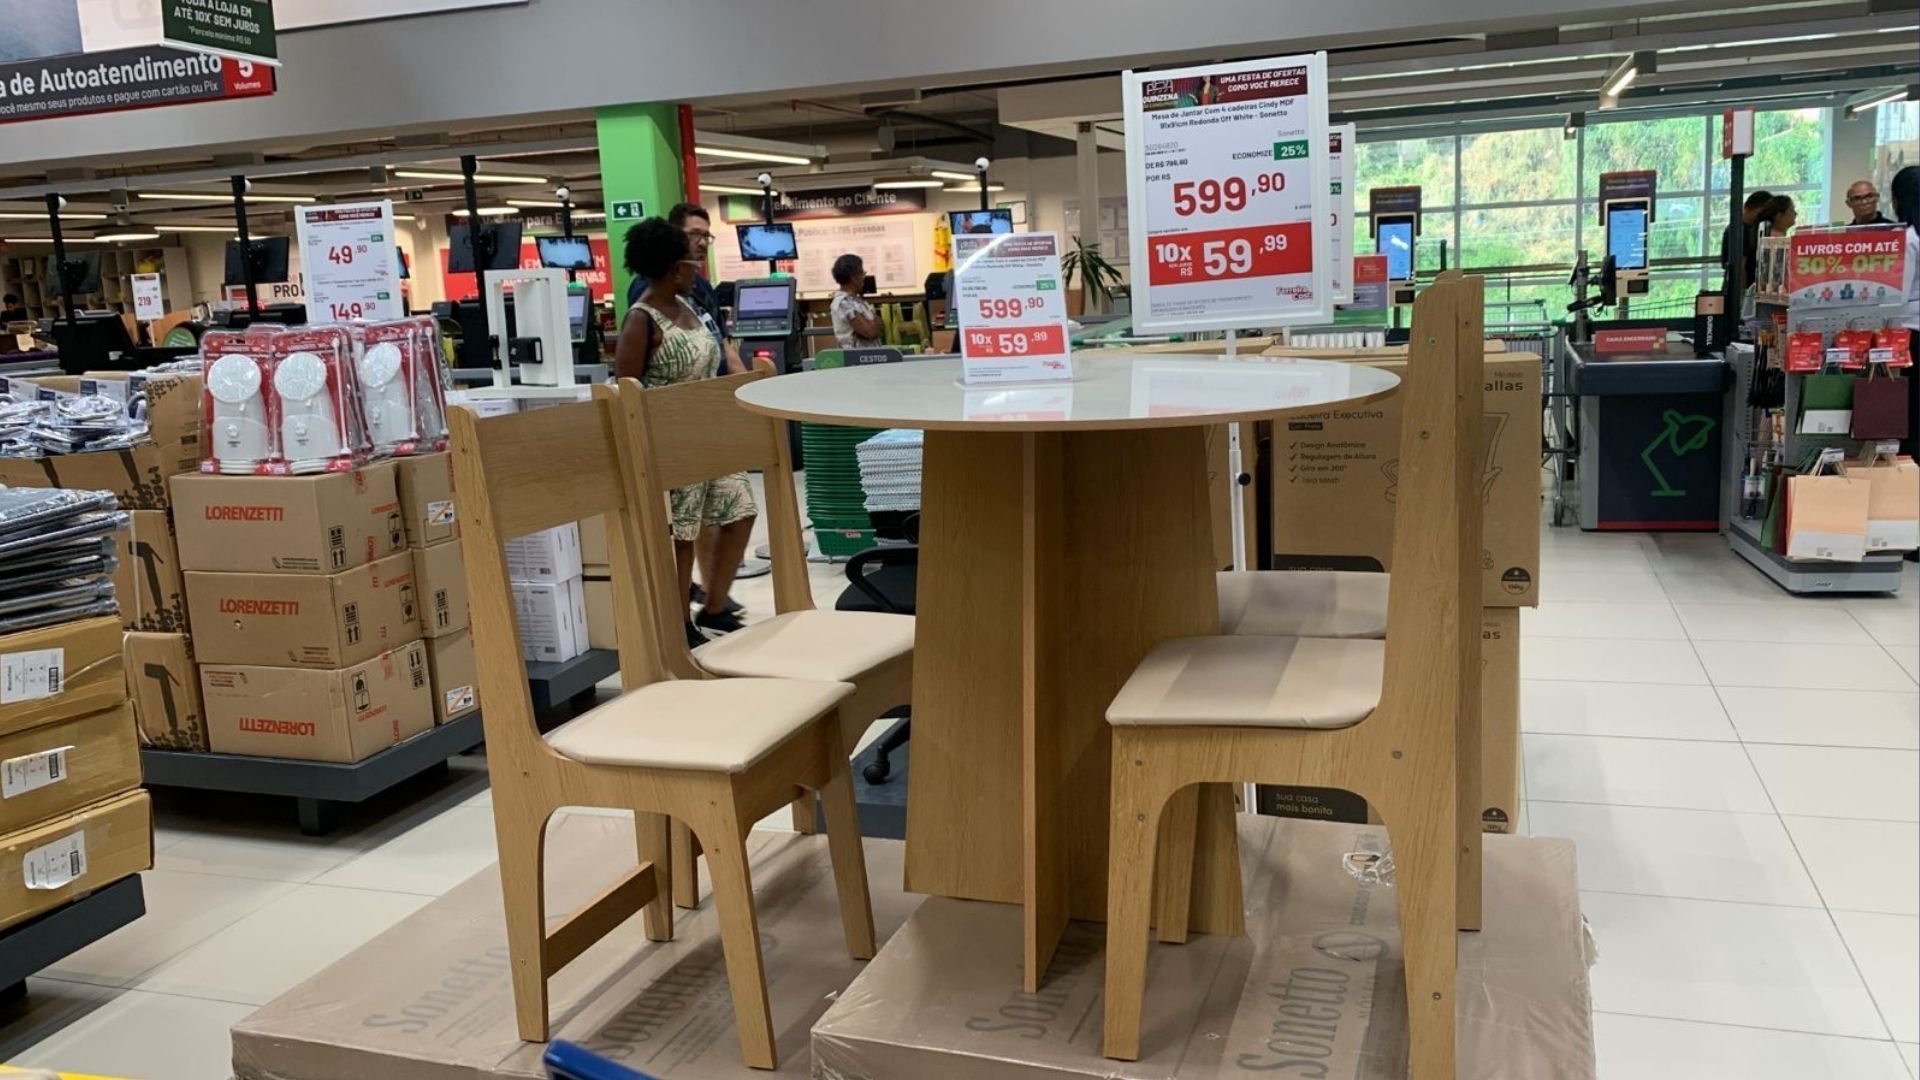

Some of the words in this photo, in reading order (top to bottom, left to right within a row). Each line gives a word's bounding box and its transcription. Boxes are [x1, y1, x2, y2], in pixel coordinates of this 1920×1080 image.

[215, 1, 239, 14] LOJA
[240, 6, 252, 17] EM
[173, 6, 193, 20] ATÉ
[194, 10, 212, 23] 10X
[213, 14, 231, 28] SEM
[233, 19, 260, 34] JUROS
[10, 72, 35, 96] de
[41, 52, 222, 93] Autoatendimento
[238, 59, 253, 78] 5
[1220, 76, 1236, 84] UMA
[1238, 73, 1261, 81] FESTA
[1273, 68, 1306, 78] OFERTAS
[233, 81, 261, 90] Volumes
[1227, 84, 1248, 92] COMO
[1250, 81, 1269, 90] VOCÊ
[1269, 78, 1299, 88] MERECE
[16, 101, 47, 113] mesmo
[47, 99, 67, 109] seus
[68, 94, 106, 109] produtos
[107, 94, 112, 102] e
[113, 91, 140, 104] pague
[141, 89, 160, 99] com
[161, 84, 190, 97] cartão
[191, 84, 203, 93] ou
[203, 80, 218, 92] Pix
[1151, 113, 1169, 121] Mesa
[1180, 109, 1203, 118] Jantar
[1204, 107, 1220, 115] Com
[1227, 104, 1258, 113] cadeiras
[1259, 101, 1278, 110] Cindy
[1280, 98, 1294, 106] MDF
[1189, 118, 1219, 127] Redonda
[1259, 110, 1288, 119] Sonetto
[1232, 149, 1273, 160] ECONOMIZE
[1281, 145, 1306, 157] 25%
[838, 196, 851, 206] ao
[1155, 243, 1192, 263] 10x
[1797, 244, 1842, 255] LIVROS
[1845, 242, 1872, 253] COM
[1875, 239, 1899, 252] ATÉ
[1852, 253, 1898, 273] OFF
[576, 271, 606, 284] SIVAS
[1180, 267, 1193, 276] R$
[970, 333, 993, 345] 10x
[860, 354, 887, 363] CESTOS
[1483, 380, 1524, 391] allas
[1333, 409, 1383, 420] Executiva
[205, 505, 283, 522] LORENZETTI
[220, 598, 299, 616] LORENZETTI
[239, 717, 315, 736] LORENZETTI
[1276, 793, 1293, 801] sua
[1295, 795, 1318, 803] casa
[1276, 803, 1299, 812] mais
[1302, 804, 1333, 815] bonita
[1236, 966, 1350, 1080] Sonetto
